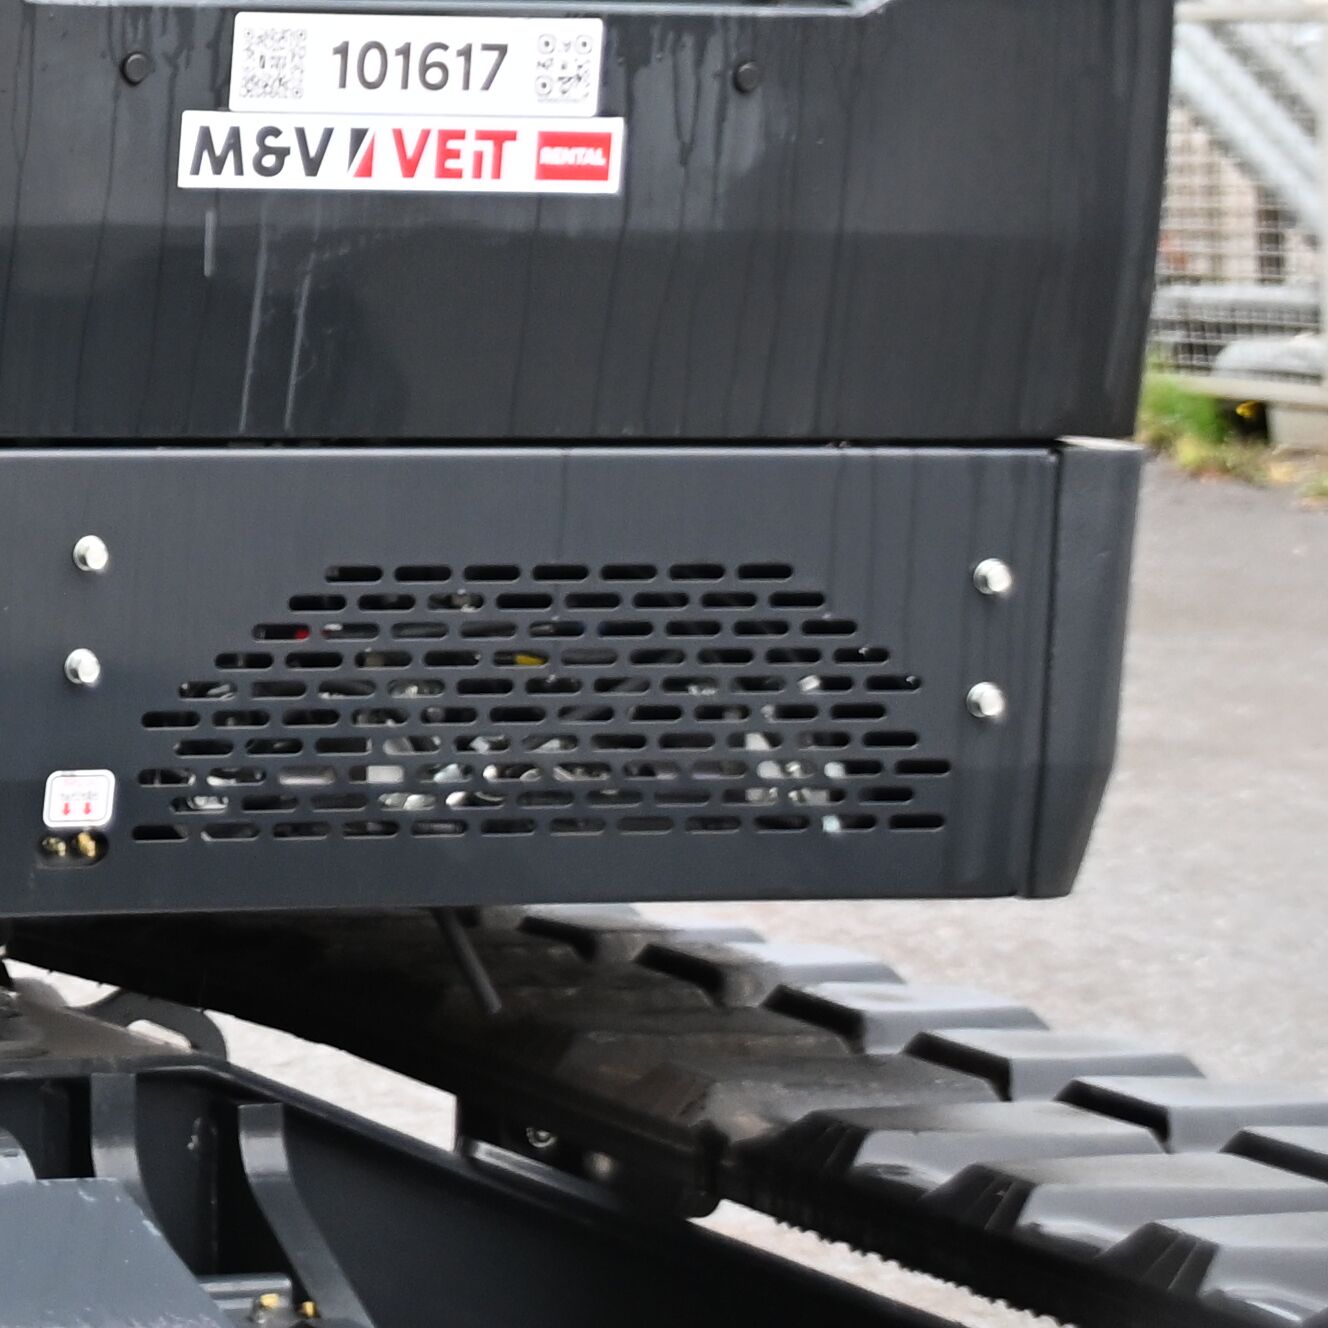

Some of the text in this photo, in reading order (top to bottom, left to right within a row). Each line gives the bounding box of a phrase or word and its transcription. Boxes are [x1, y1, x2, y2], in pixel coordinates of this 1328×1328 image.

[332, 40, 509, 91] 101617
[189, 125, 607, 180] M&V VEIT RENTAL
